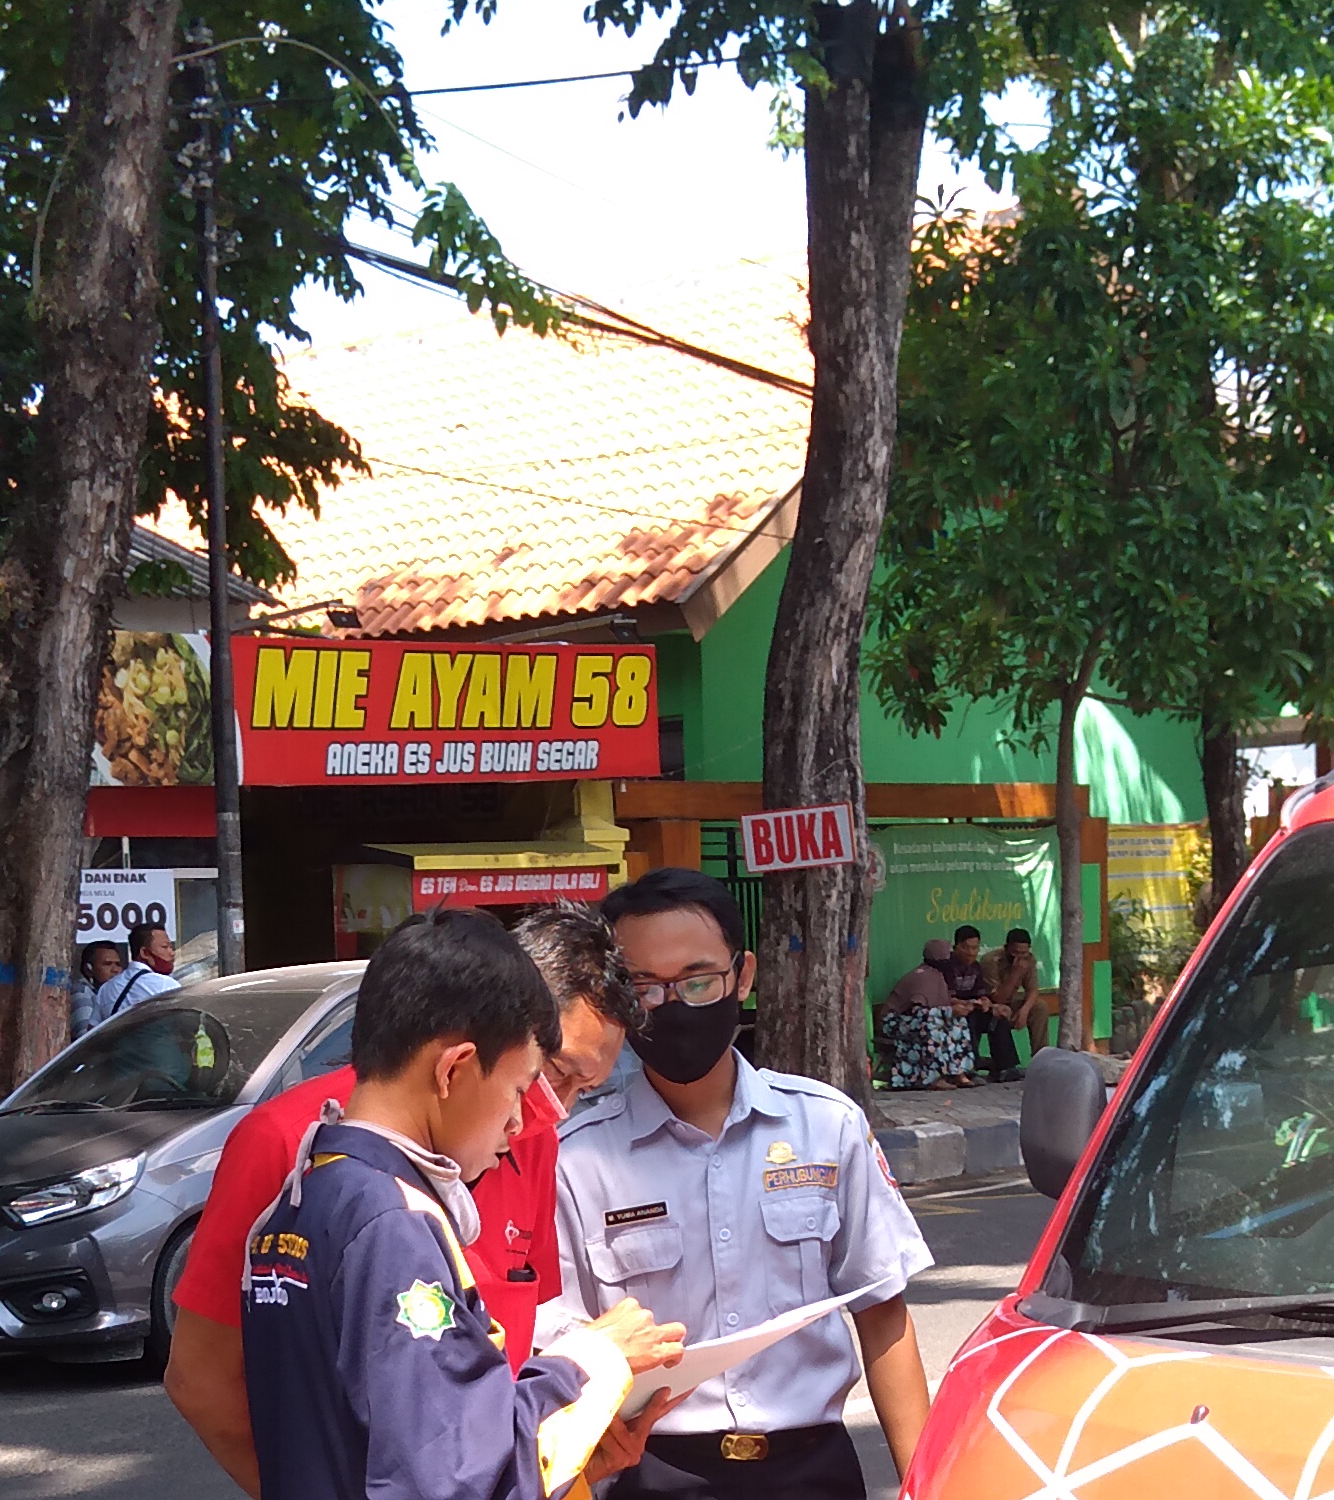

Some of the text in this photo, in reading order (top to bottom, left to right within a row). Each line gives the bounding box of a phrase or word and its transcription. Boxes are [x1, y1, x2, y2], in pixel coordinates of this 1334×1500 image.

[251, 647, 652, 730] MIE AYAM 58
[326, 740, 599, 776] ANEKA ES JUS BUAH SEGAR
[751, 811, 844, 866] BUKA
[84, 873, 146, 884] DAN ENAK
[420, 877, 435, 894] ES
[437, 877, 457, 894] TEH
[480, 876, 493, 893] ES
[77, 902, 167, 931] 5000
[926, 887, 1024, 929] Sebaliknya
[767, 1165, 837, 1188] PERHUBUNGAN
